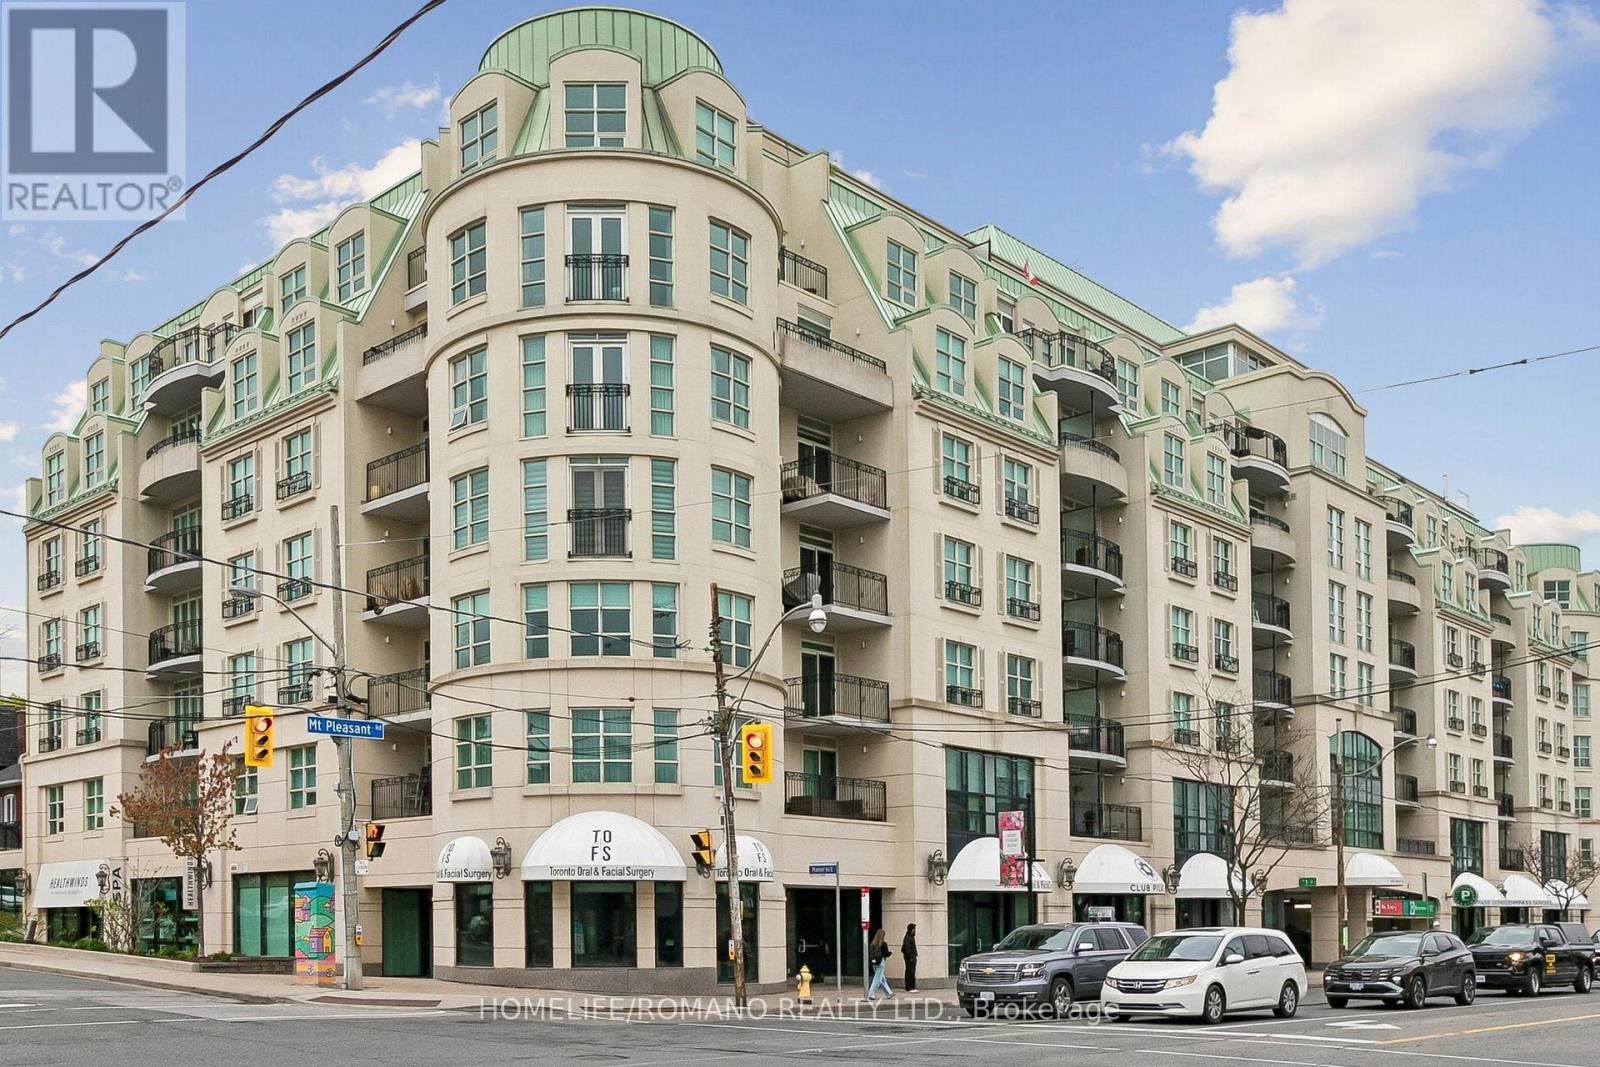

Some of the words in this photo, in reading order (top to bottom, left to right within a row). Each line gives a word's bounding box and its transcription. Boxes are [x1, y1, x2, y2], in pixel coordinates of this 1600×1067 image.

[309, 719, 321, 731] Mt
[326, 720, 371, 735] Pleasant
[593, 830, 612, 843] TO
[591, 846, 611, 861] FS
[444, 869, 462, 878] Facial
[463, 868, 492, 880] Surgery
[550, 866, 576, 877] Toronto
[577, 866, 593, 877] Oral
[594, 866, 600, 877] &
[602, 866, 625, 877] Facial
[626, 866, 655, 878] Surgery
[745, 867, 758, 877] Oral
[49, 876, 89, 888] HEALTHWINDS
[113, 867, 121, 901] SPA
[1130, 884, 1151, 892] CLUB
[1461, 890, 1470, 901] P
